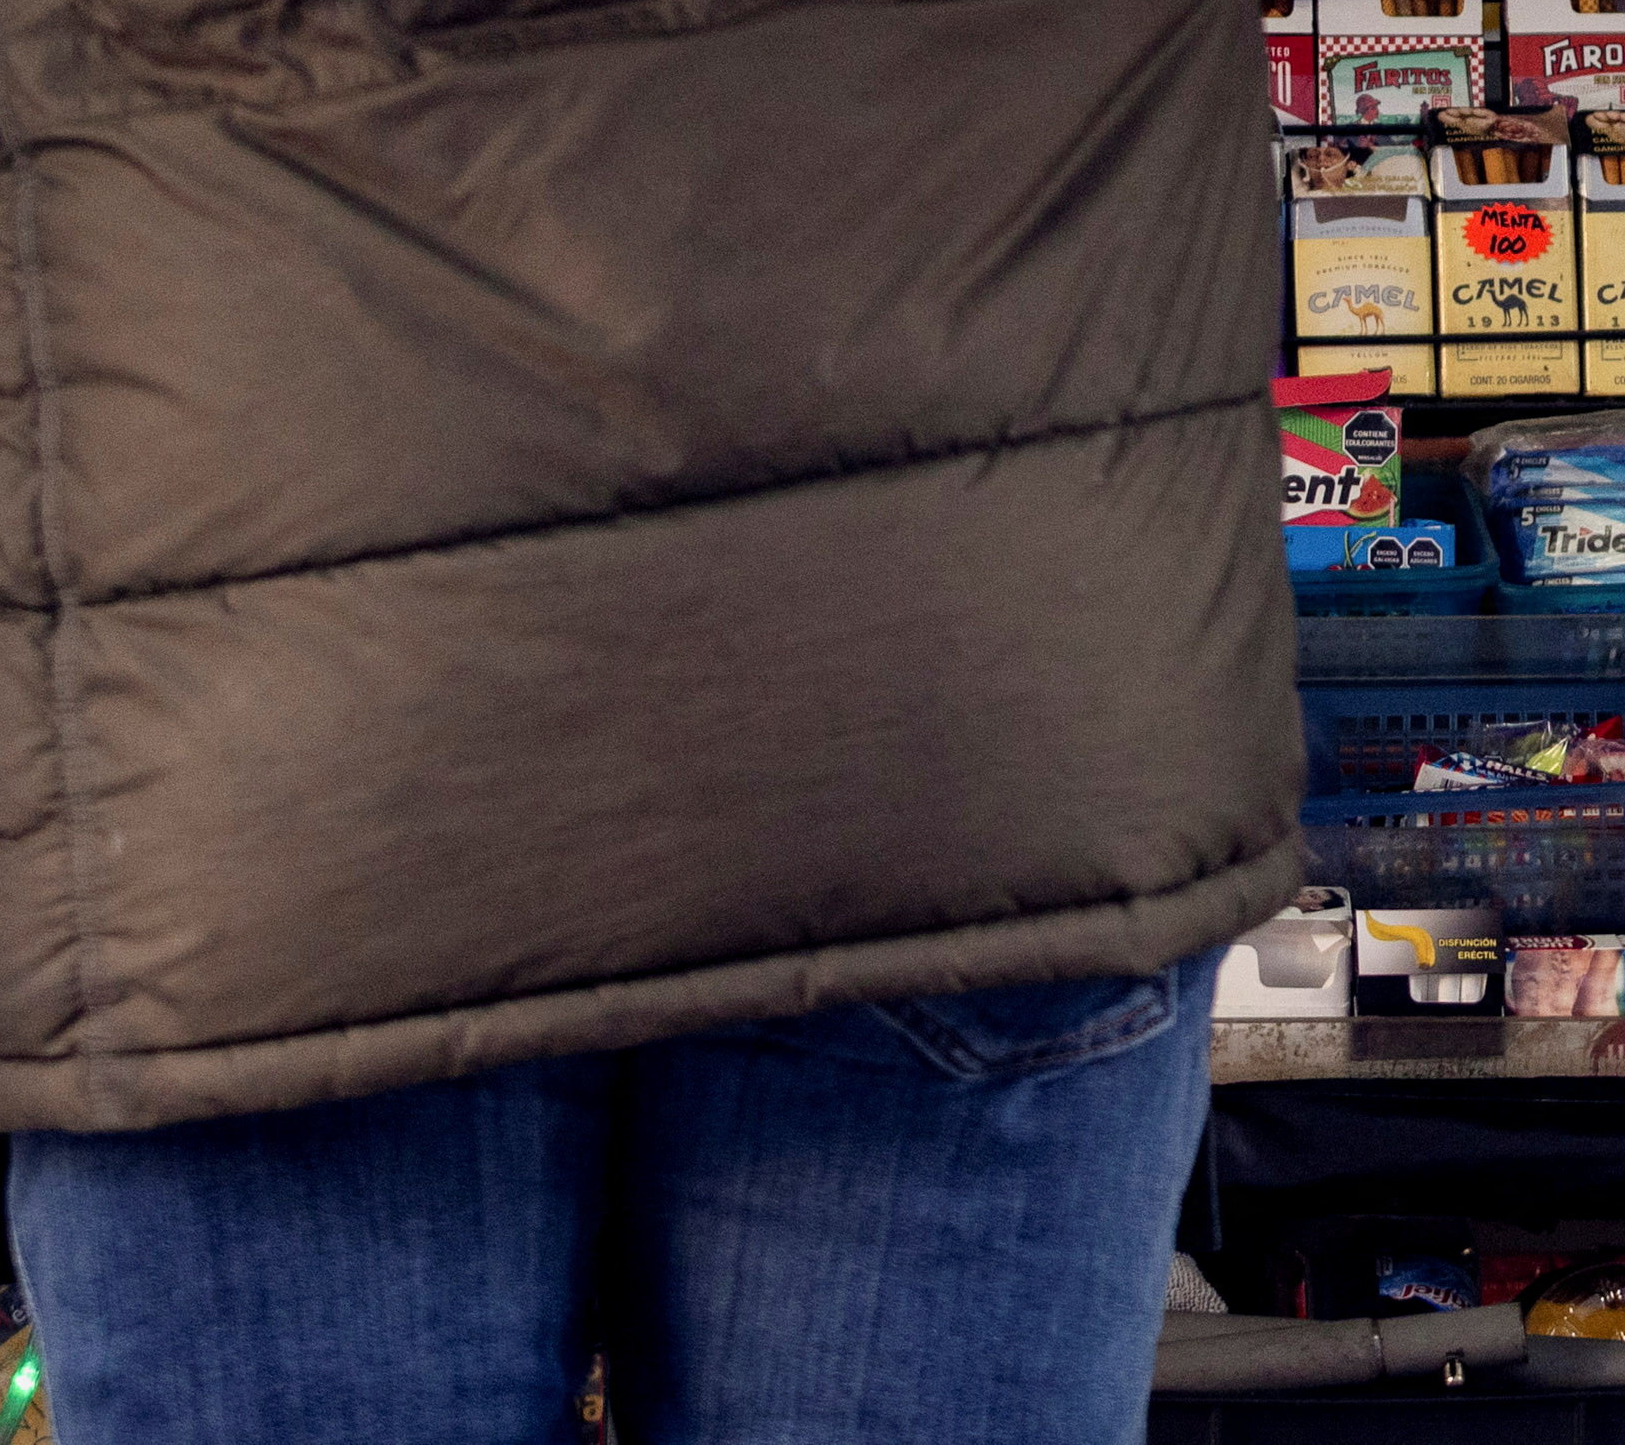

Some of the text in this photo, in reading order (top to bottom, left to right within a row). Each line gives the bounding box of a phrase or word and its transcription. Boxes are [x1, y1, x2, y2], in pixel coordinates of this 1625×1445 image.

[1354, 61, 1452, 92] FARITOS
[1480, 209, 1545, 230] MENTA
[1490, 235, 1526, 254] 100
[1452, 278, 1563, 303] CAMEL
[1509, 375, 1551, 385] CIGARROS
